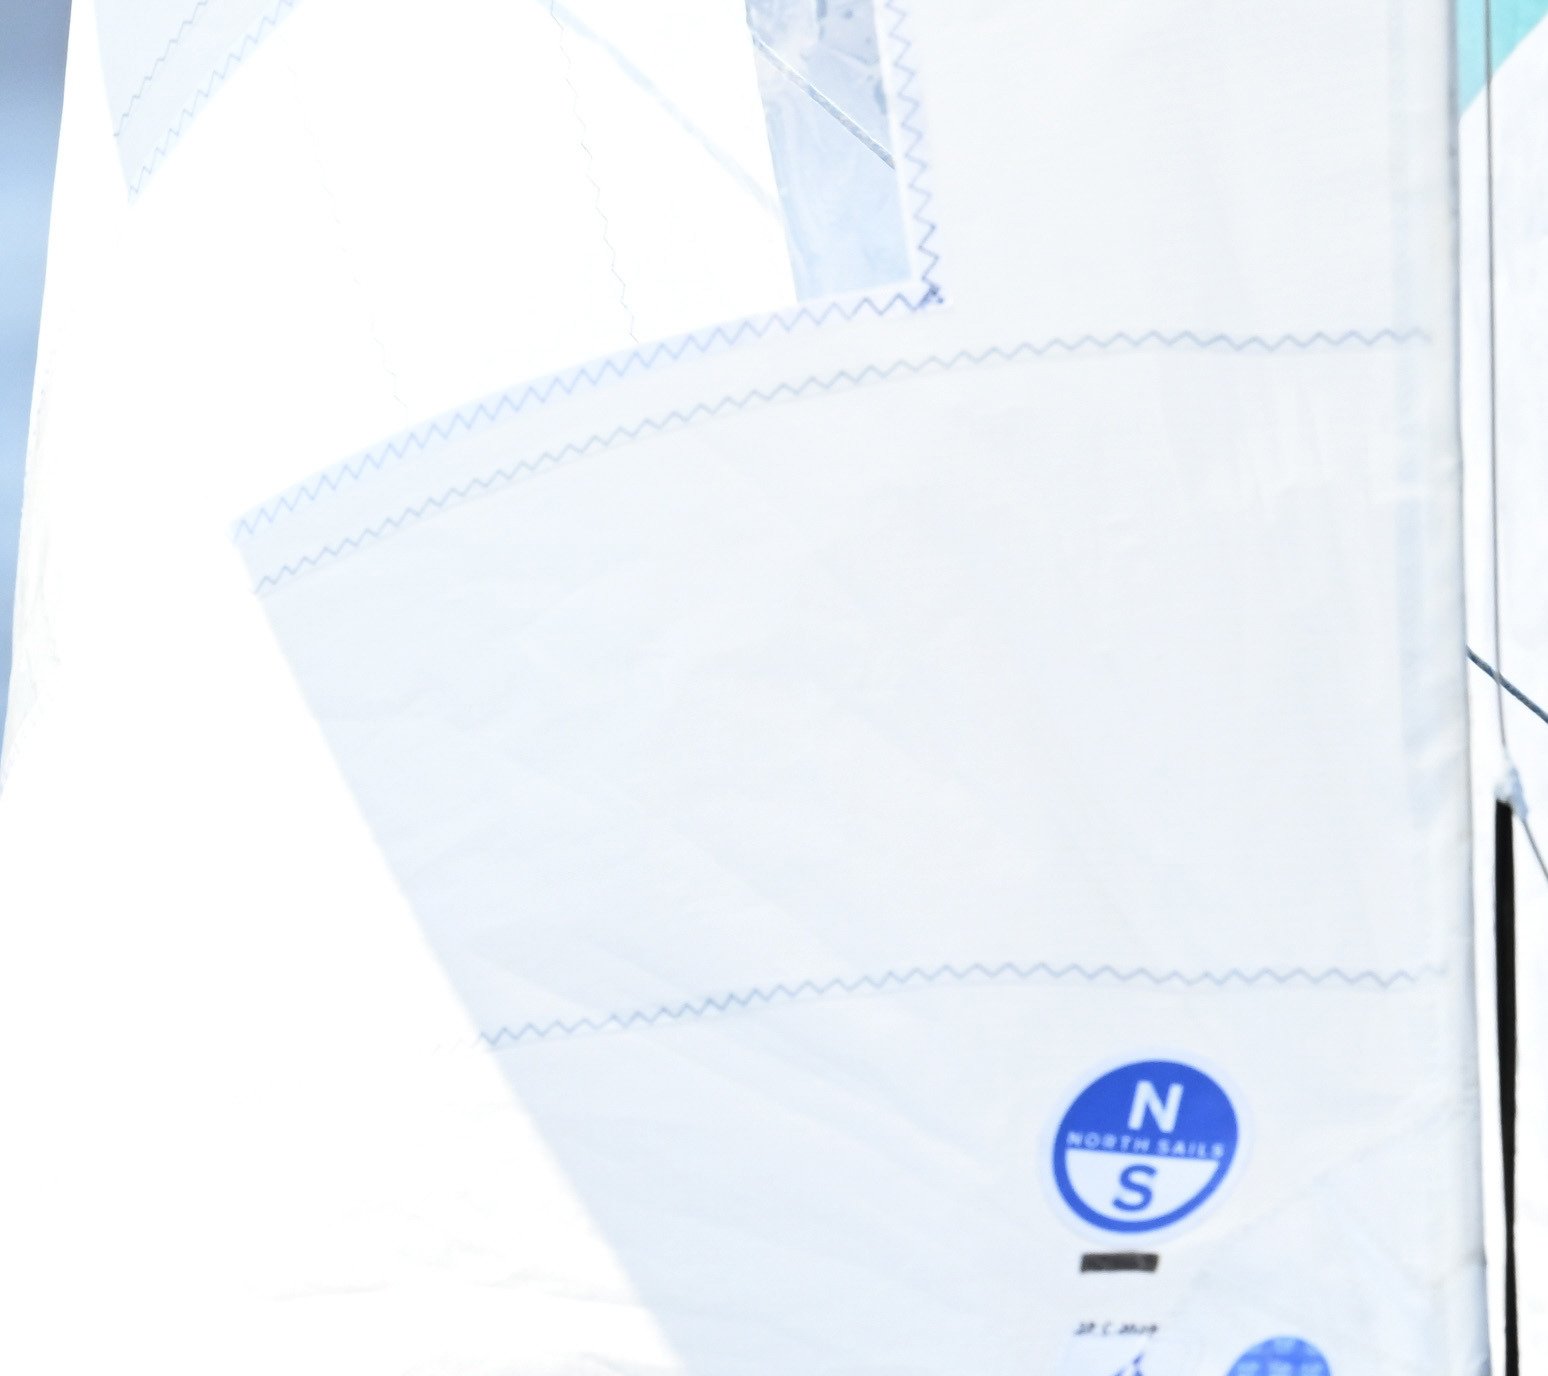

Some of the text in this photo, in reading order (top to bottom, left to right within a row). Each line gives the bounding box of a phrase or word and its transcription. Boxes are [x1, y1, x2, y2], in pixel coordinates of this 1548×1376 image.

[1128, 1080, 1184, 1133] N
[1066, 1130, 1225, 1161] NORTH SAILS
[1112, 1163, 1158, 1212] S
